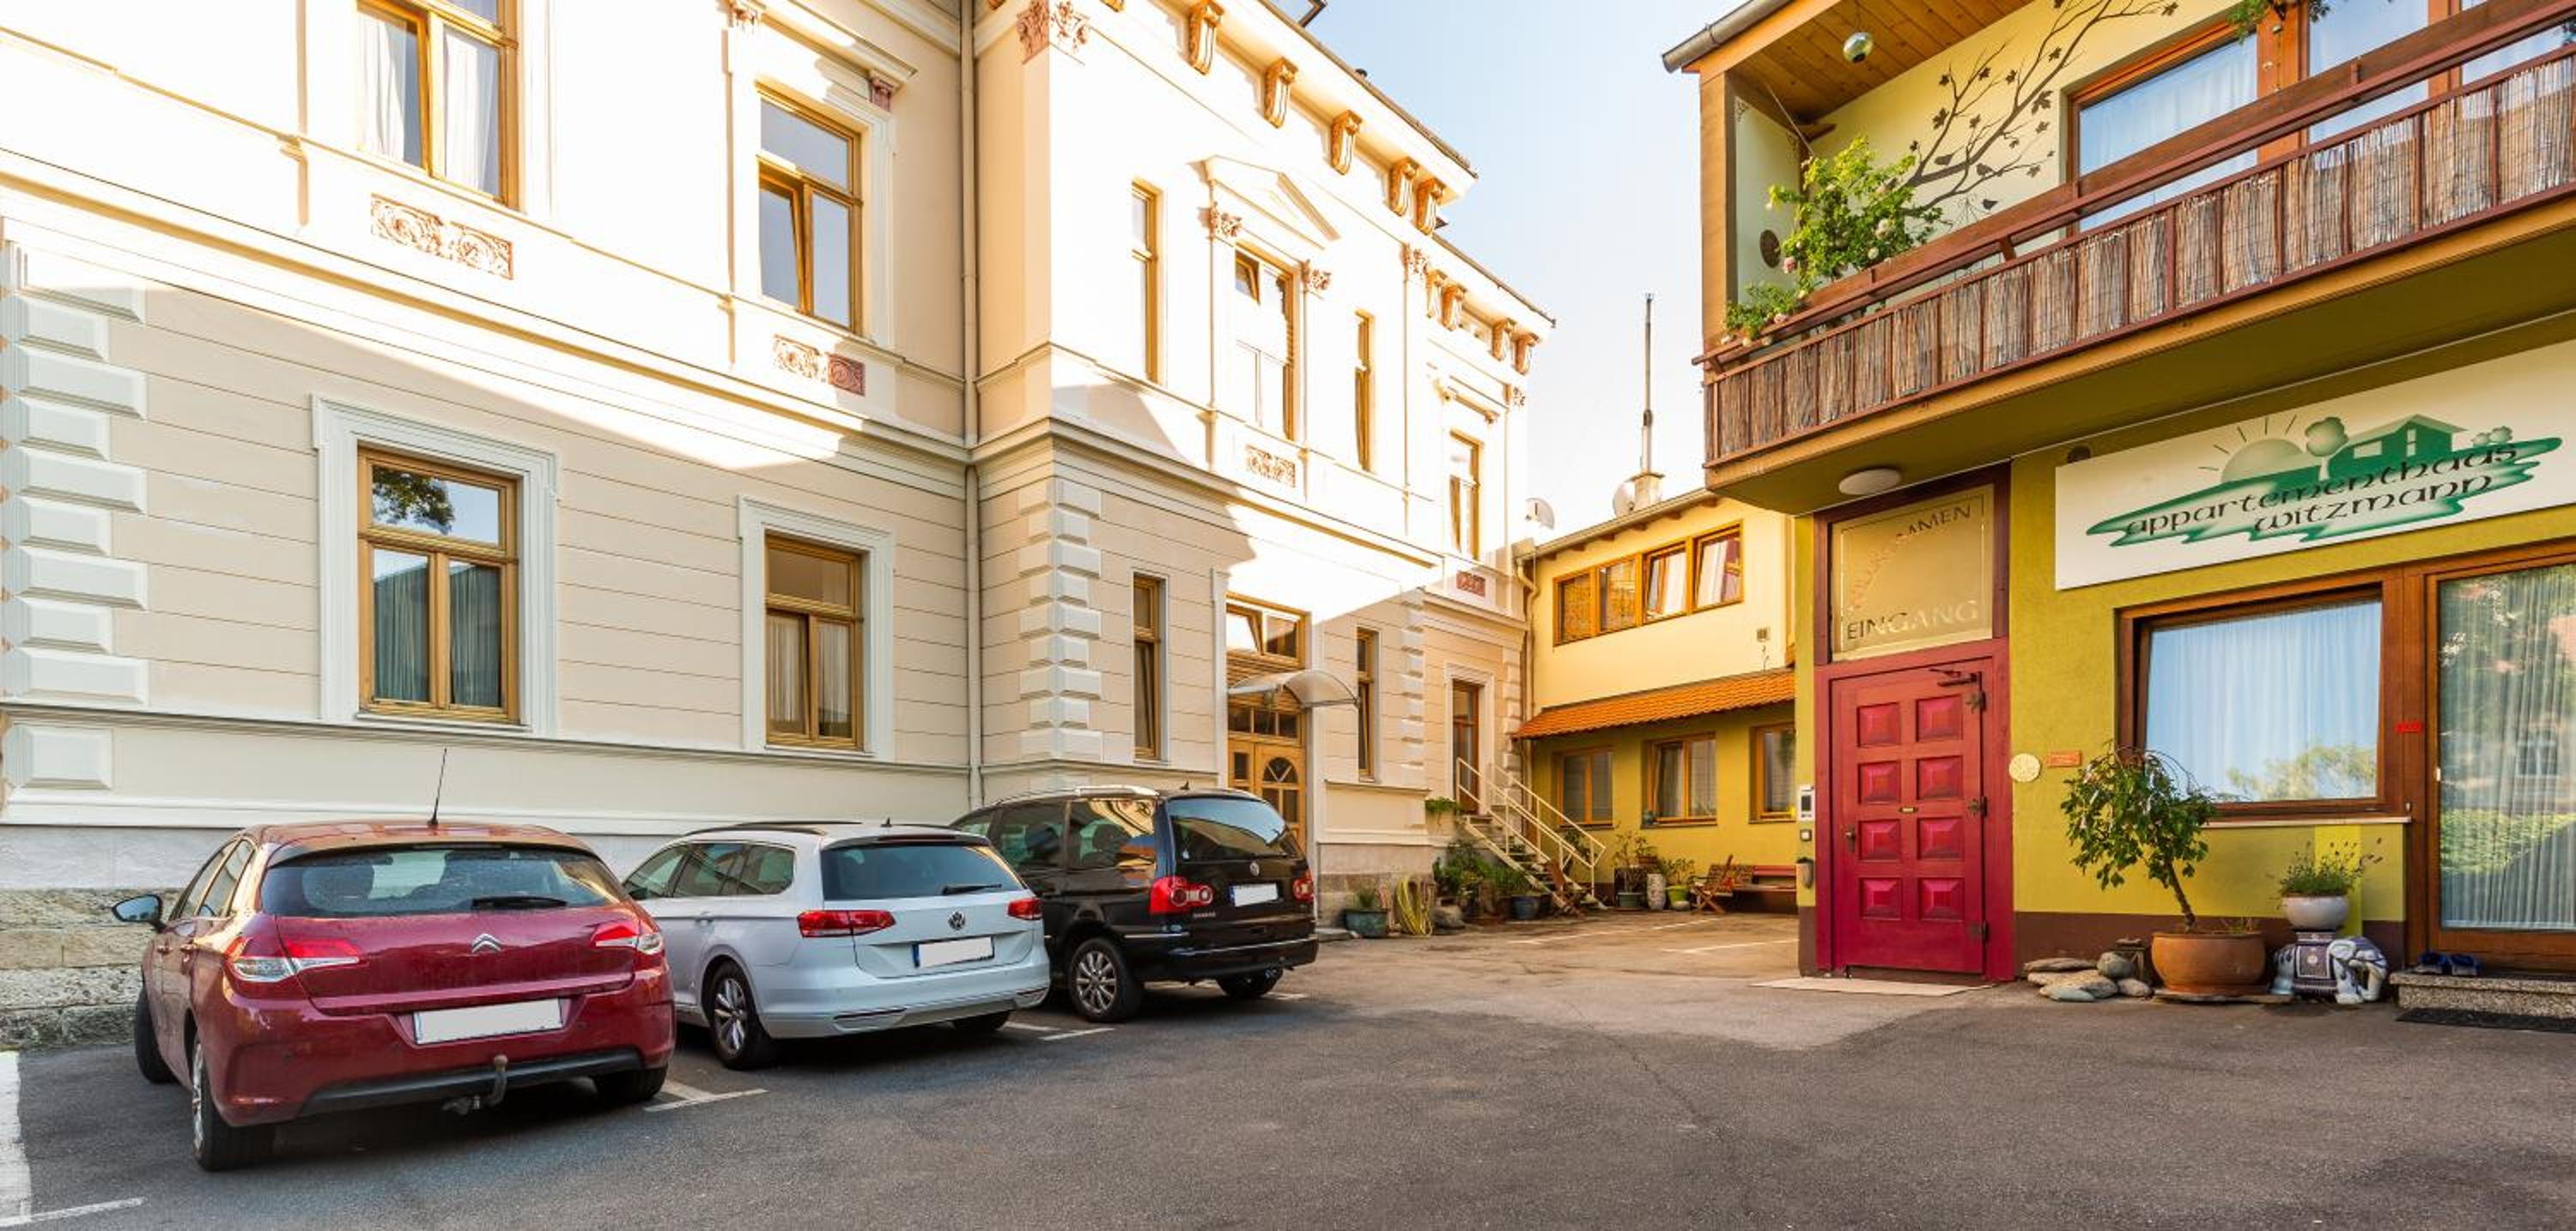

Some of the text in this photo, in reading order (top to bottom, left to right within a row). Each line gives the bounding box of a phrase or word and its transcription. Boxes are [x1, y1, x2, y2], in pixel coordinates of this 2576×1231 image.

[2125, 444, 2517, 536] appartementhaus
[2254, 475, 2492, 531] witzmann
[1847, 599, 1979, 640] EINGANG
